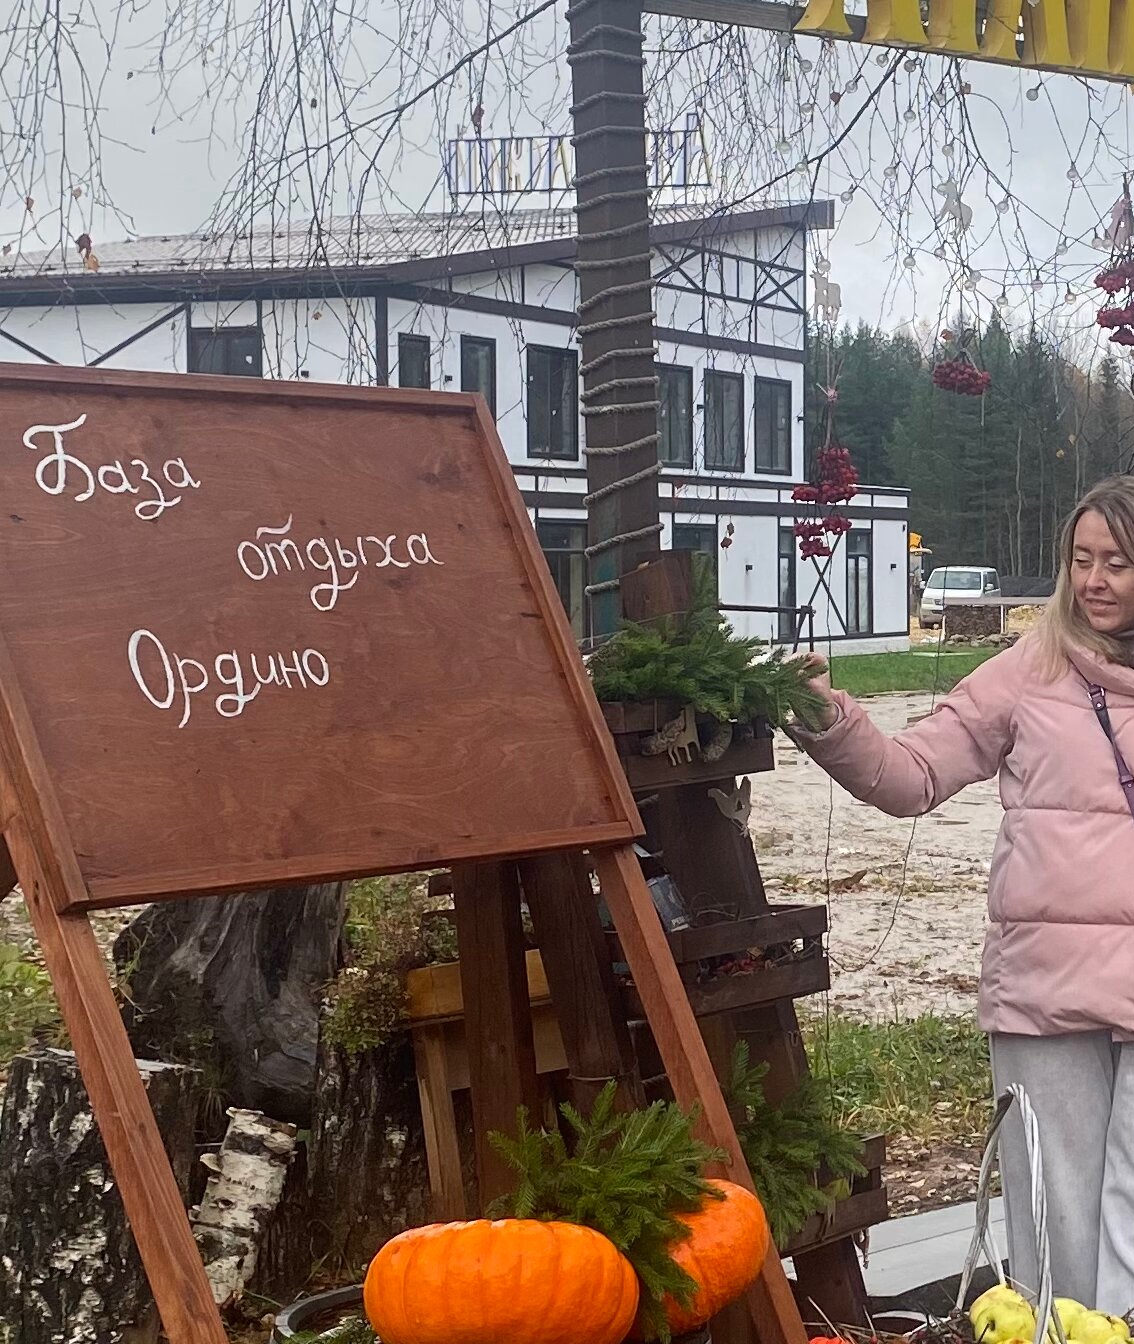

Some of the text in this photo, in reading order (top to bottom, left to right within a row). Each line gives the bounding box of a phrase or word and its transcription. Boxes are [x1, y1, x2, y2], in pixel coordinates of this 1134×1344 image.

[23, 414, 201, 520] База
[237, 514, 444, 610] отдыха
[127, 629, 331, 728] Ордино
